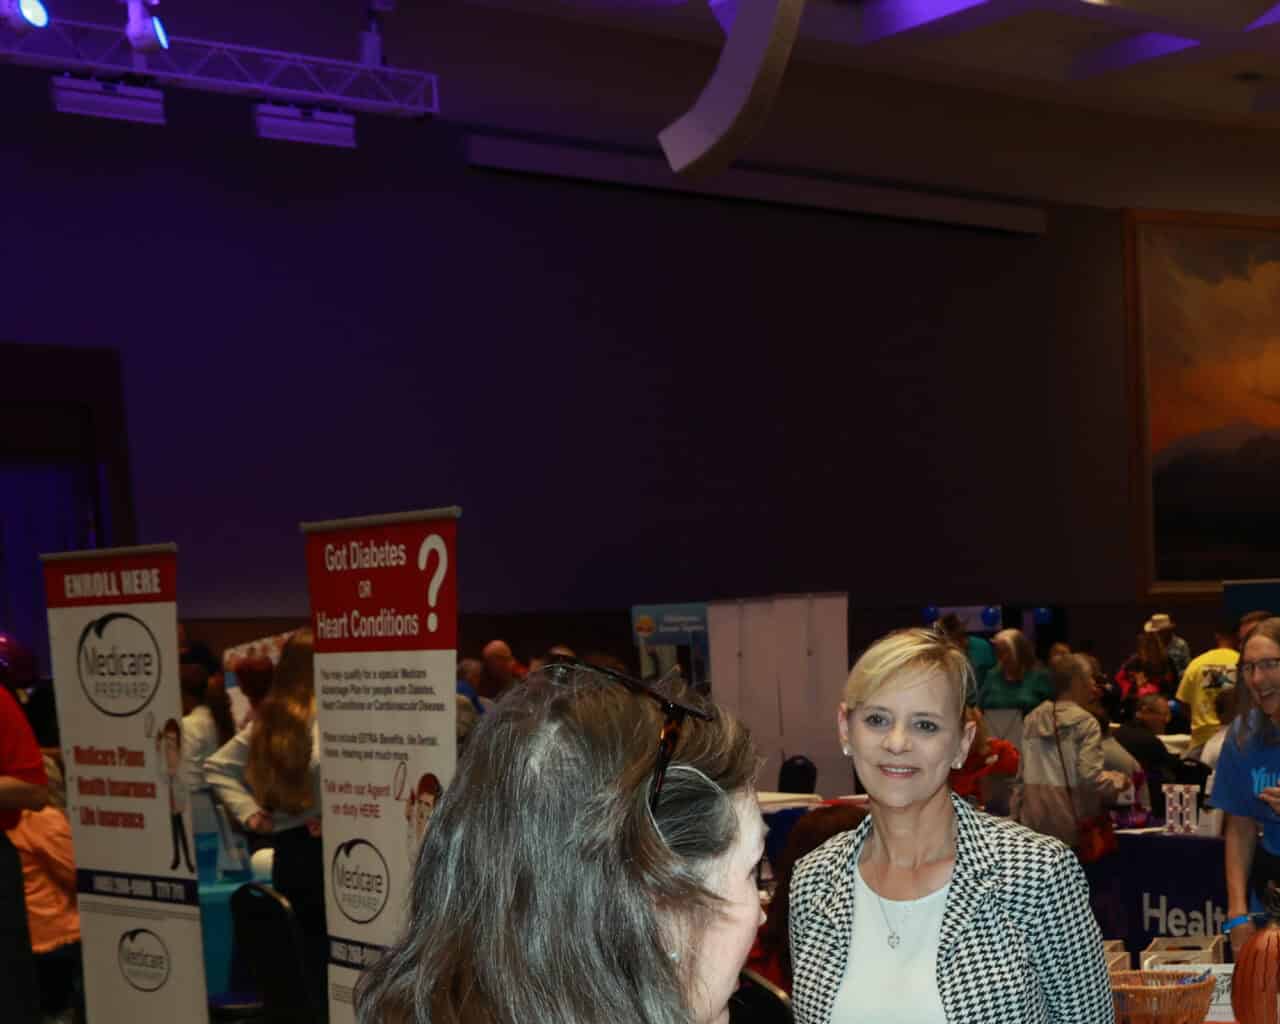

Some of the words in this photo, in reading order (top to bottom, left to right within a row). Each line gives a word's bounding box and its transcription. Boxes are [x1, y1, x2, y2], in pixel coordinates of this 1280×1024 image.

[325, 543, 348, 571] Got
[350, 539, 407, 569] Diabetes
[63, 571, 120, 599] ENROLL
[120, 568, 162, 595] HERE
[358, 580, 372, 598] OR
[317, 611, 348, 639] Heart
[351, 608, 419, 638] Conditions
[83, 645, 153, 677] Medicare
[1142, 891, 1226, 937] Healt
